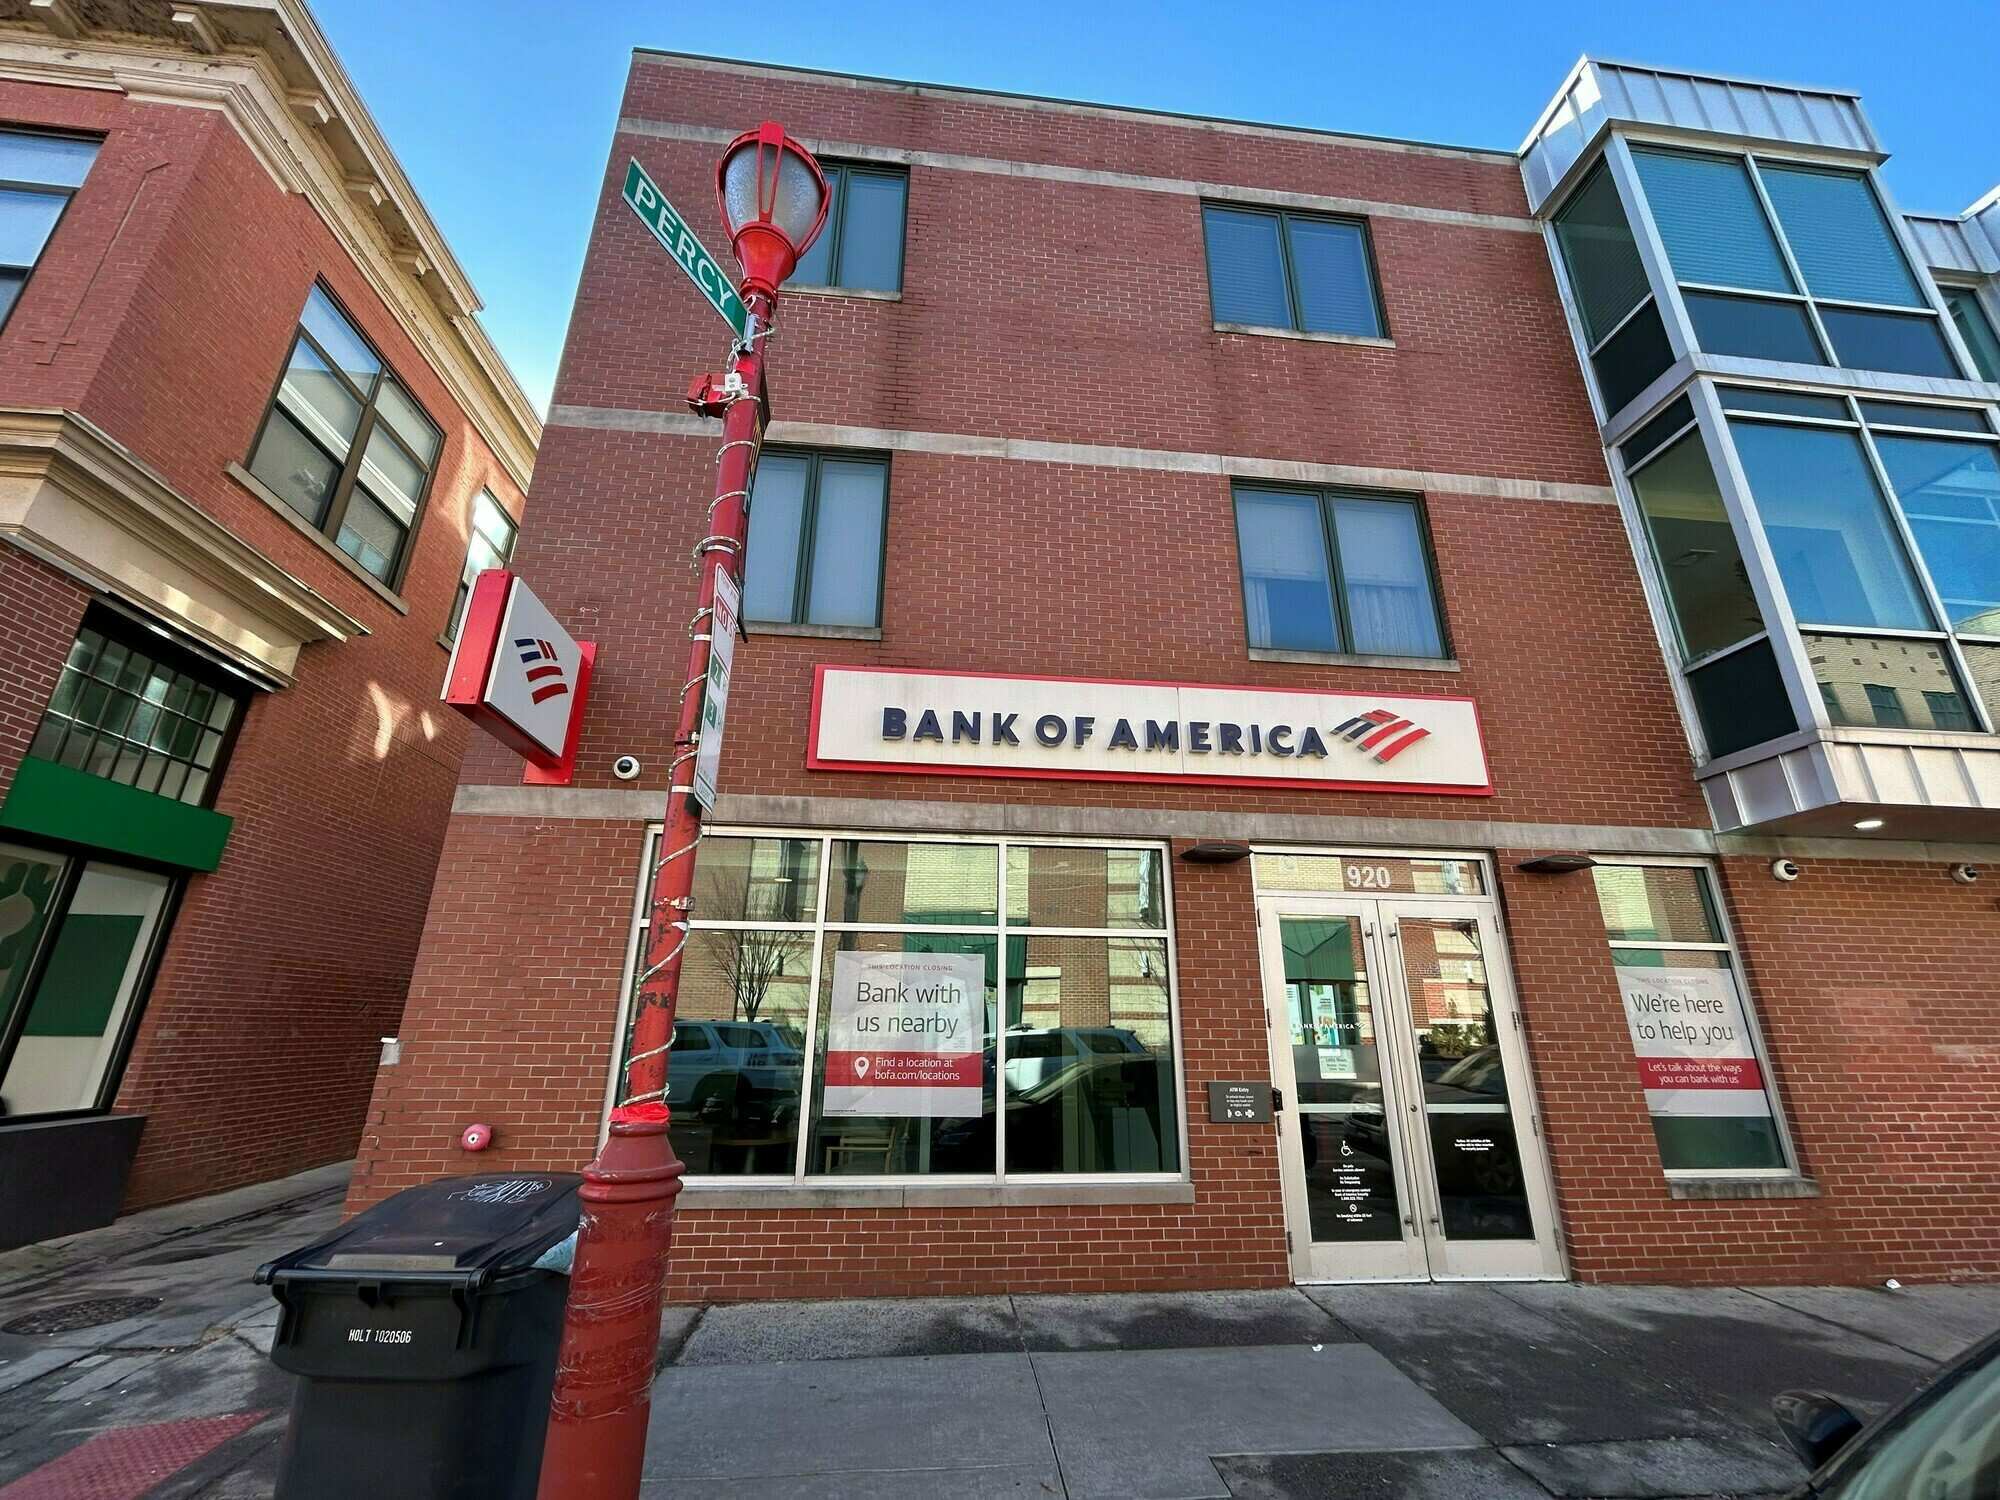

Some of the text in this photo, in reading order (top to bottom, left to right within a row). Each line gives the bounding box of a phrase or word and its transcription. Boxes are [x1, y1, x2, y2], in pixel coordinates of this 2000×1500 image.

[634, 177, 733, 308] PERCY
[882, 706, 1329, 759] BANK OF AMERICA
[1346, 865, 1391, 888] 920
[857, 982, 961, 1004] Bank with
[1631, 993, 1724, 1013] We're here
[856, 1012, 959, 1039] us nearby
[1637, 1020, 1735, 1045] to help you
[875, 1057, 896, 1067] Find
[906, 1057, 942, 1068] location
[944, 1058, 953, 1068] at
[1648, 1062, 1743, 1074] Let's talk about the ways
[875, 1069, 960, 1080] bofa.com/locations
[1659, 1075, 1674, 1086] you
[1675, 1075, 1689, 1084] can
[1690, 1074, 1709, 1084] bank
[1710, 1074, 1728, 1084] with
[374, 1329, 412, 1343] 1020506
